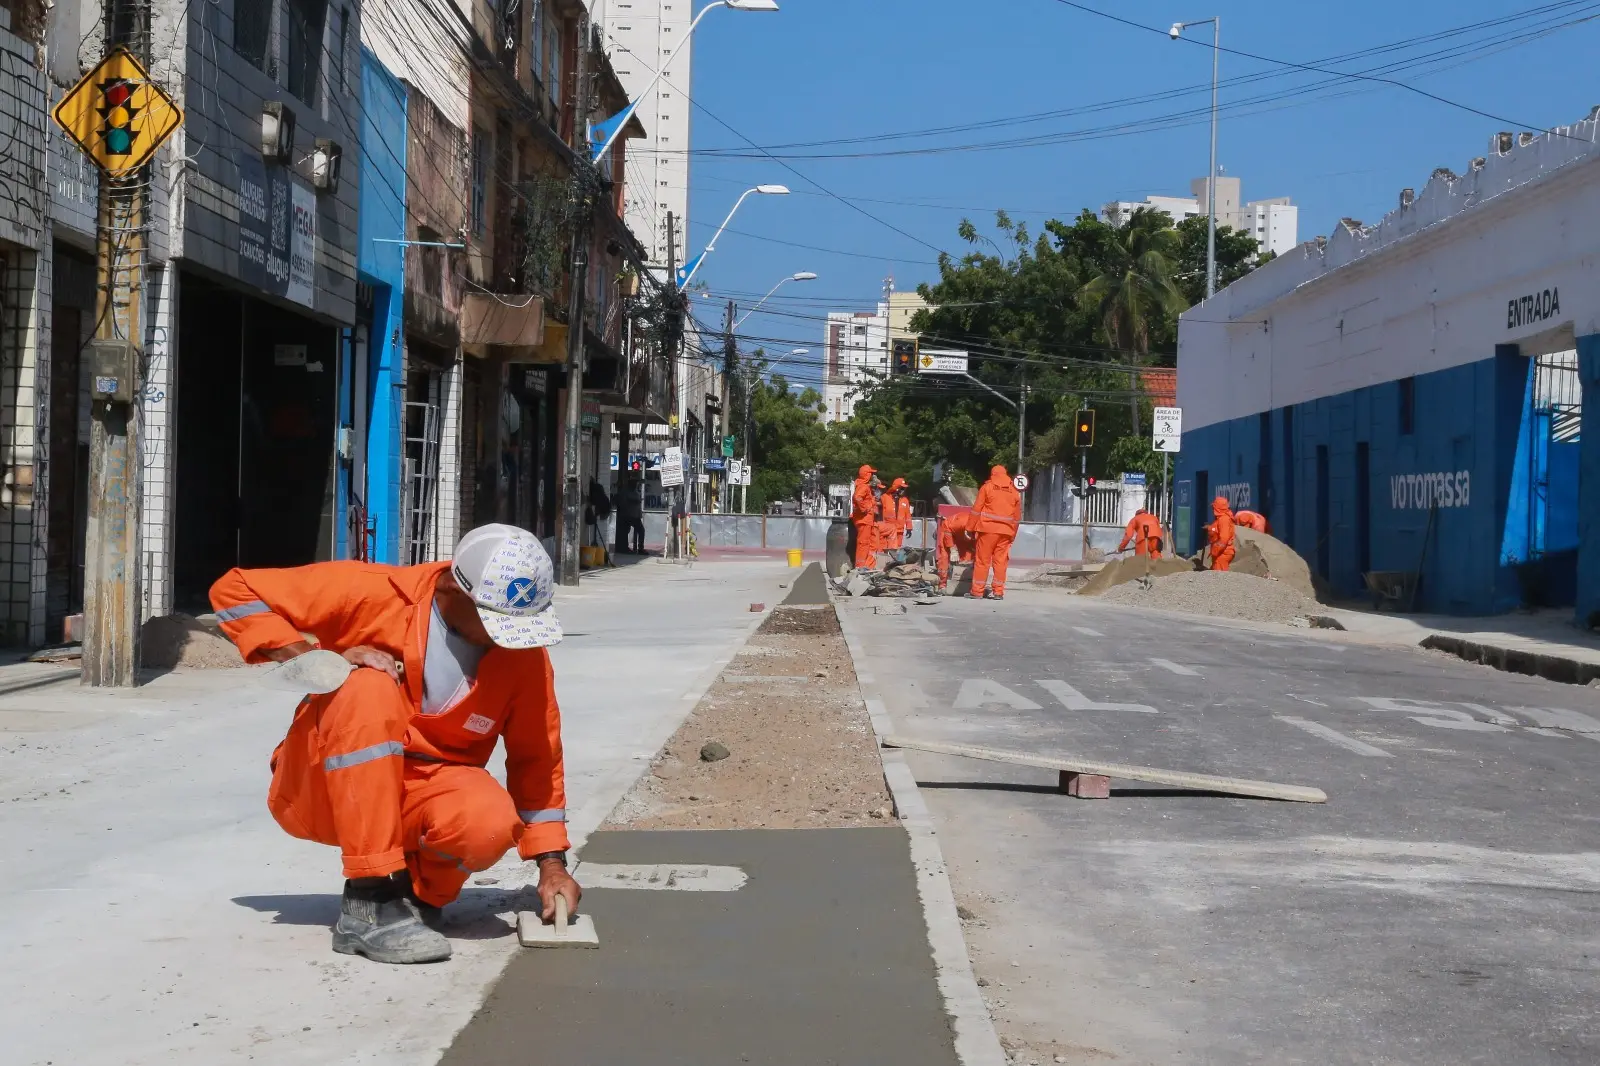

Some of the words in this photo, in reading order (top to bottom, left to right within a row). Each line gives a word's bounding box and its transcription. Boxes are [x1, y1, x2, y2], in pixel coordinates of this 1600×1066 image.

[291, 203, 315, 240] MEGA
[267, 250, 289, 282] alugue
[1507, 286, 1560, 329] ENTRADA
